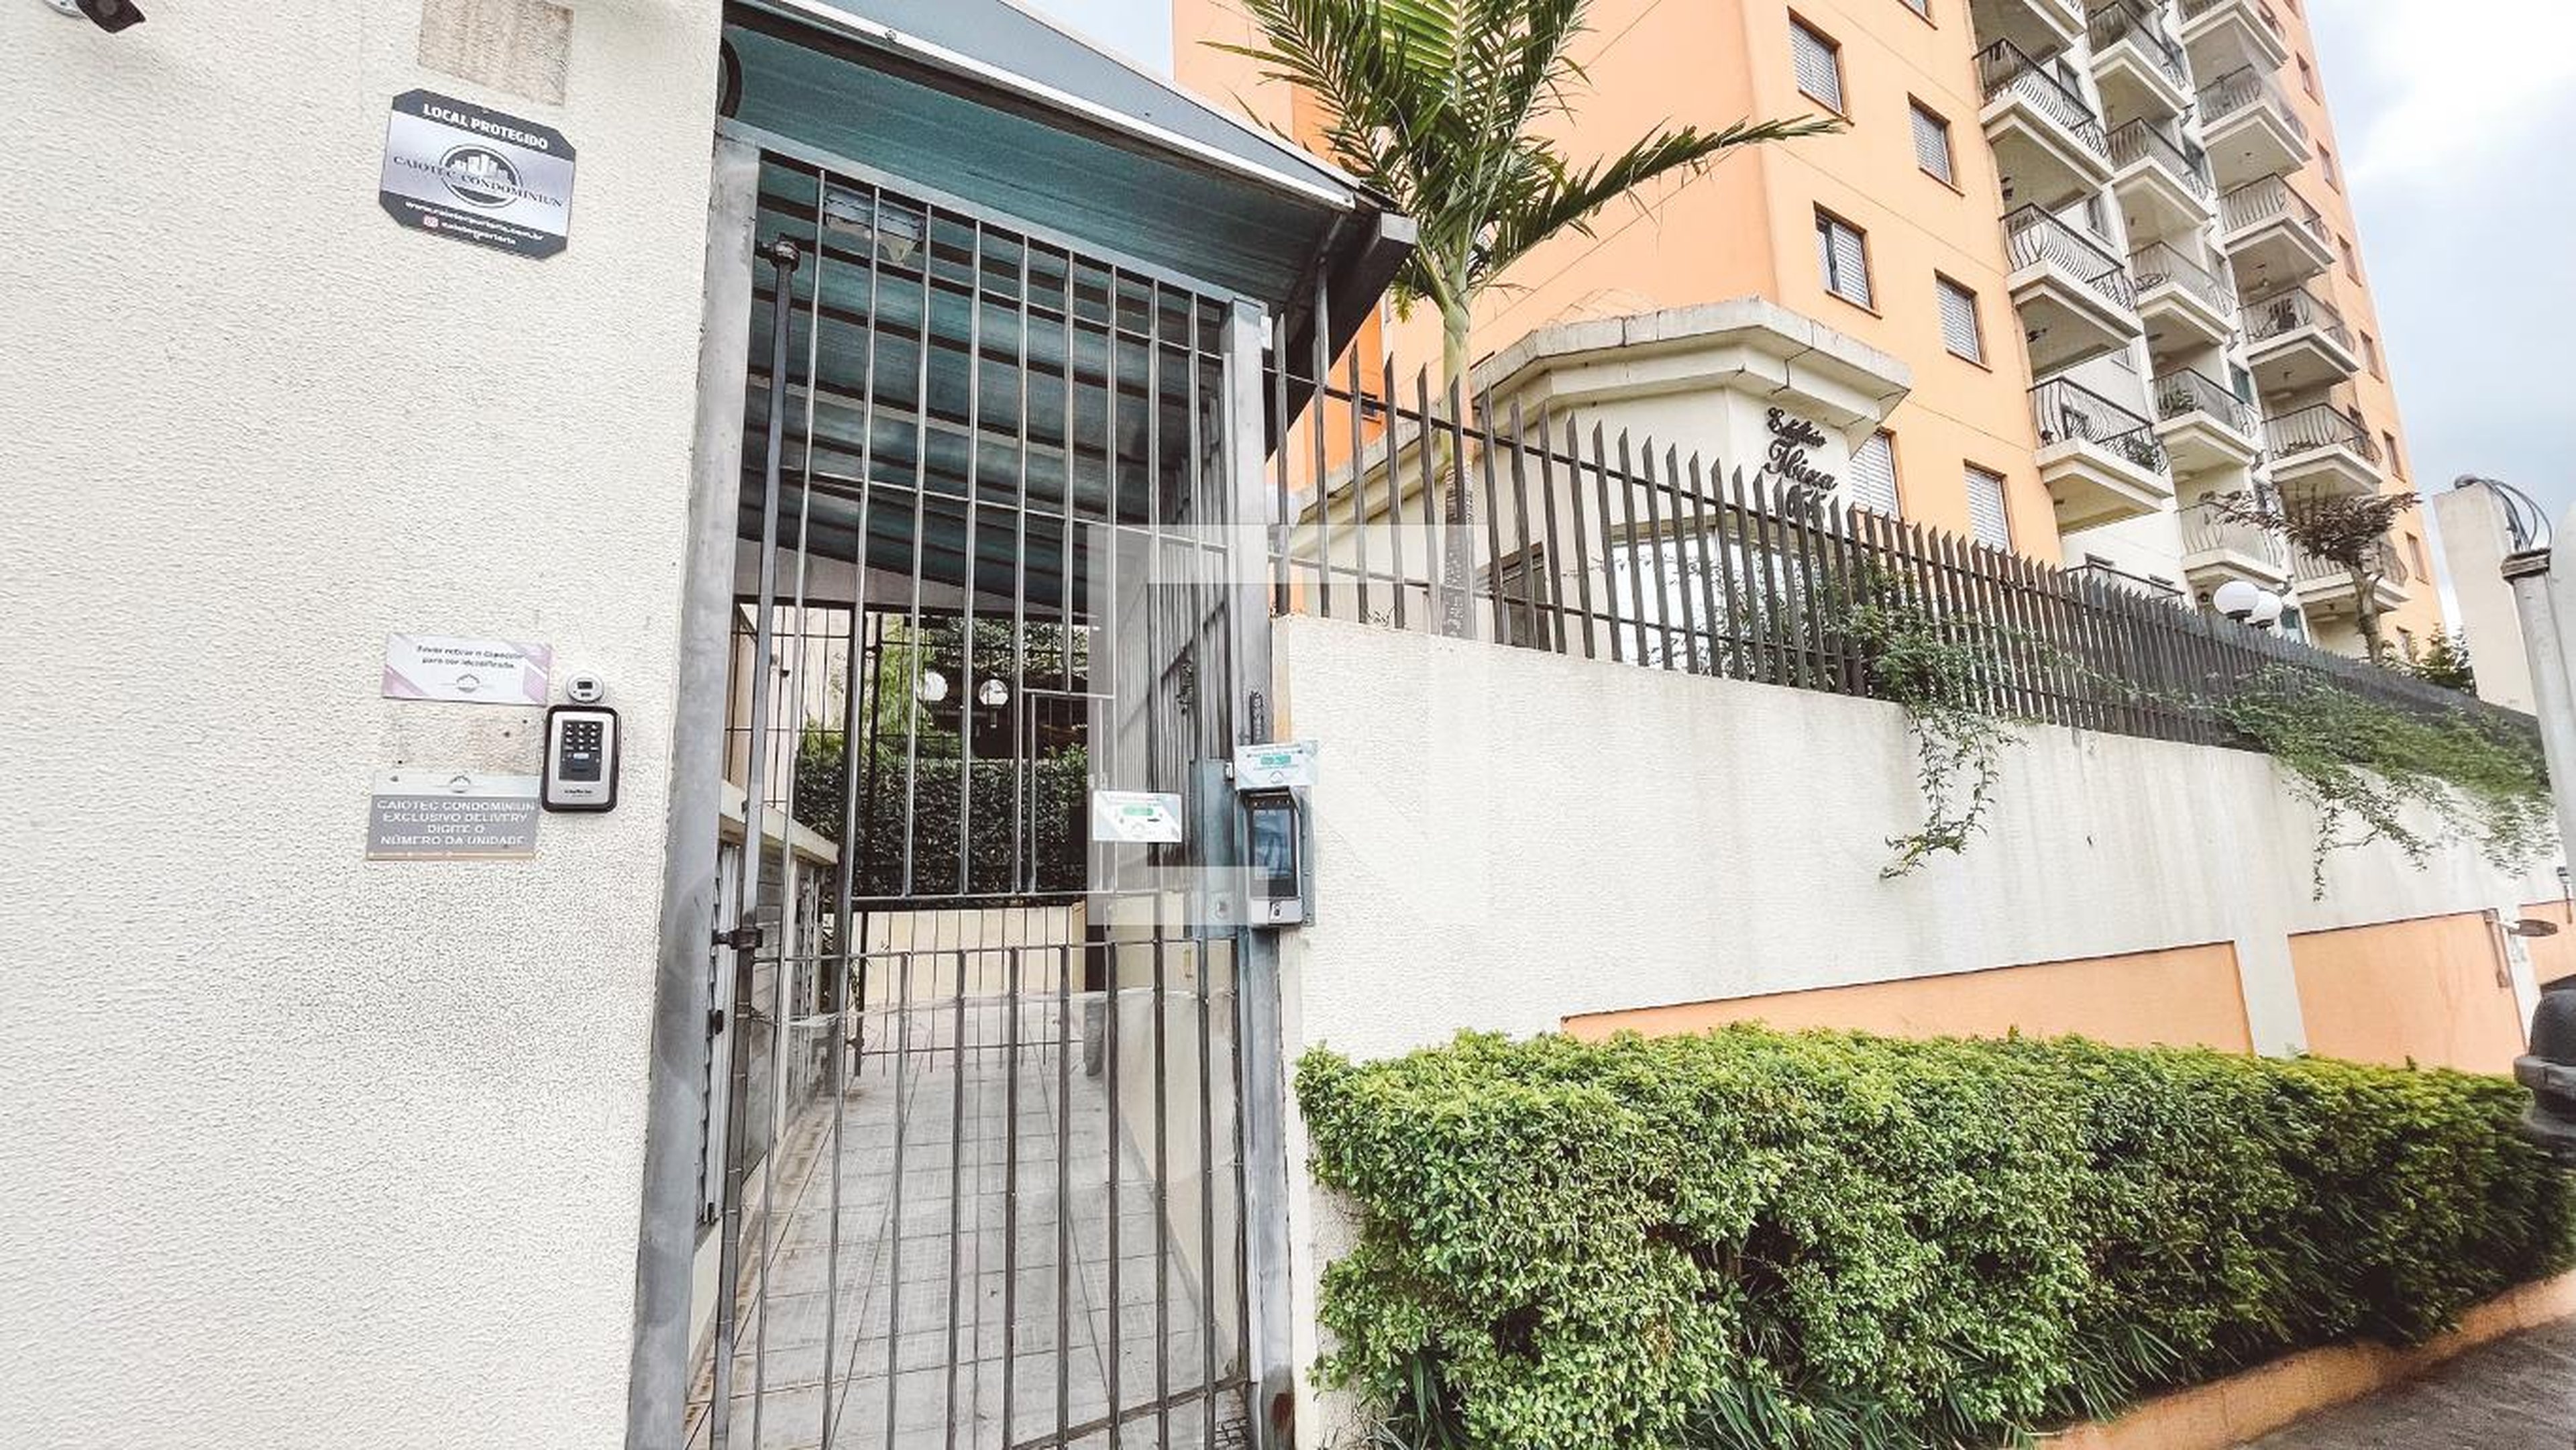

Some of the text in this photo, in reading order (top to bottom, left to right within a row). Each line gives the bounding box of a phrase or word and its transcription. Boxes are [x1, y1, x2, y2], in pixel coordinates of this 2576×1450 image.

[422, 103, 549, 150] LOCAL PROTEGIDO
[392, 155, 456, 178] CAIOTEC
[377, 800, 440, 811] CAIOTEC
[382, 812, 528, 823] EXCLUSIVO DELIVERY
[427, 824, 486, 834] DIGITE O
[380, 833, 525, 845] NÚMERO DA UNIDADE
